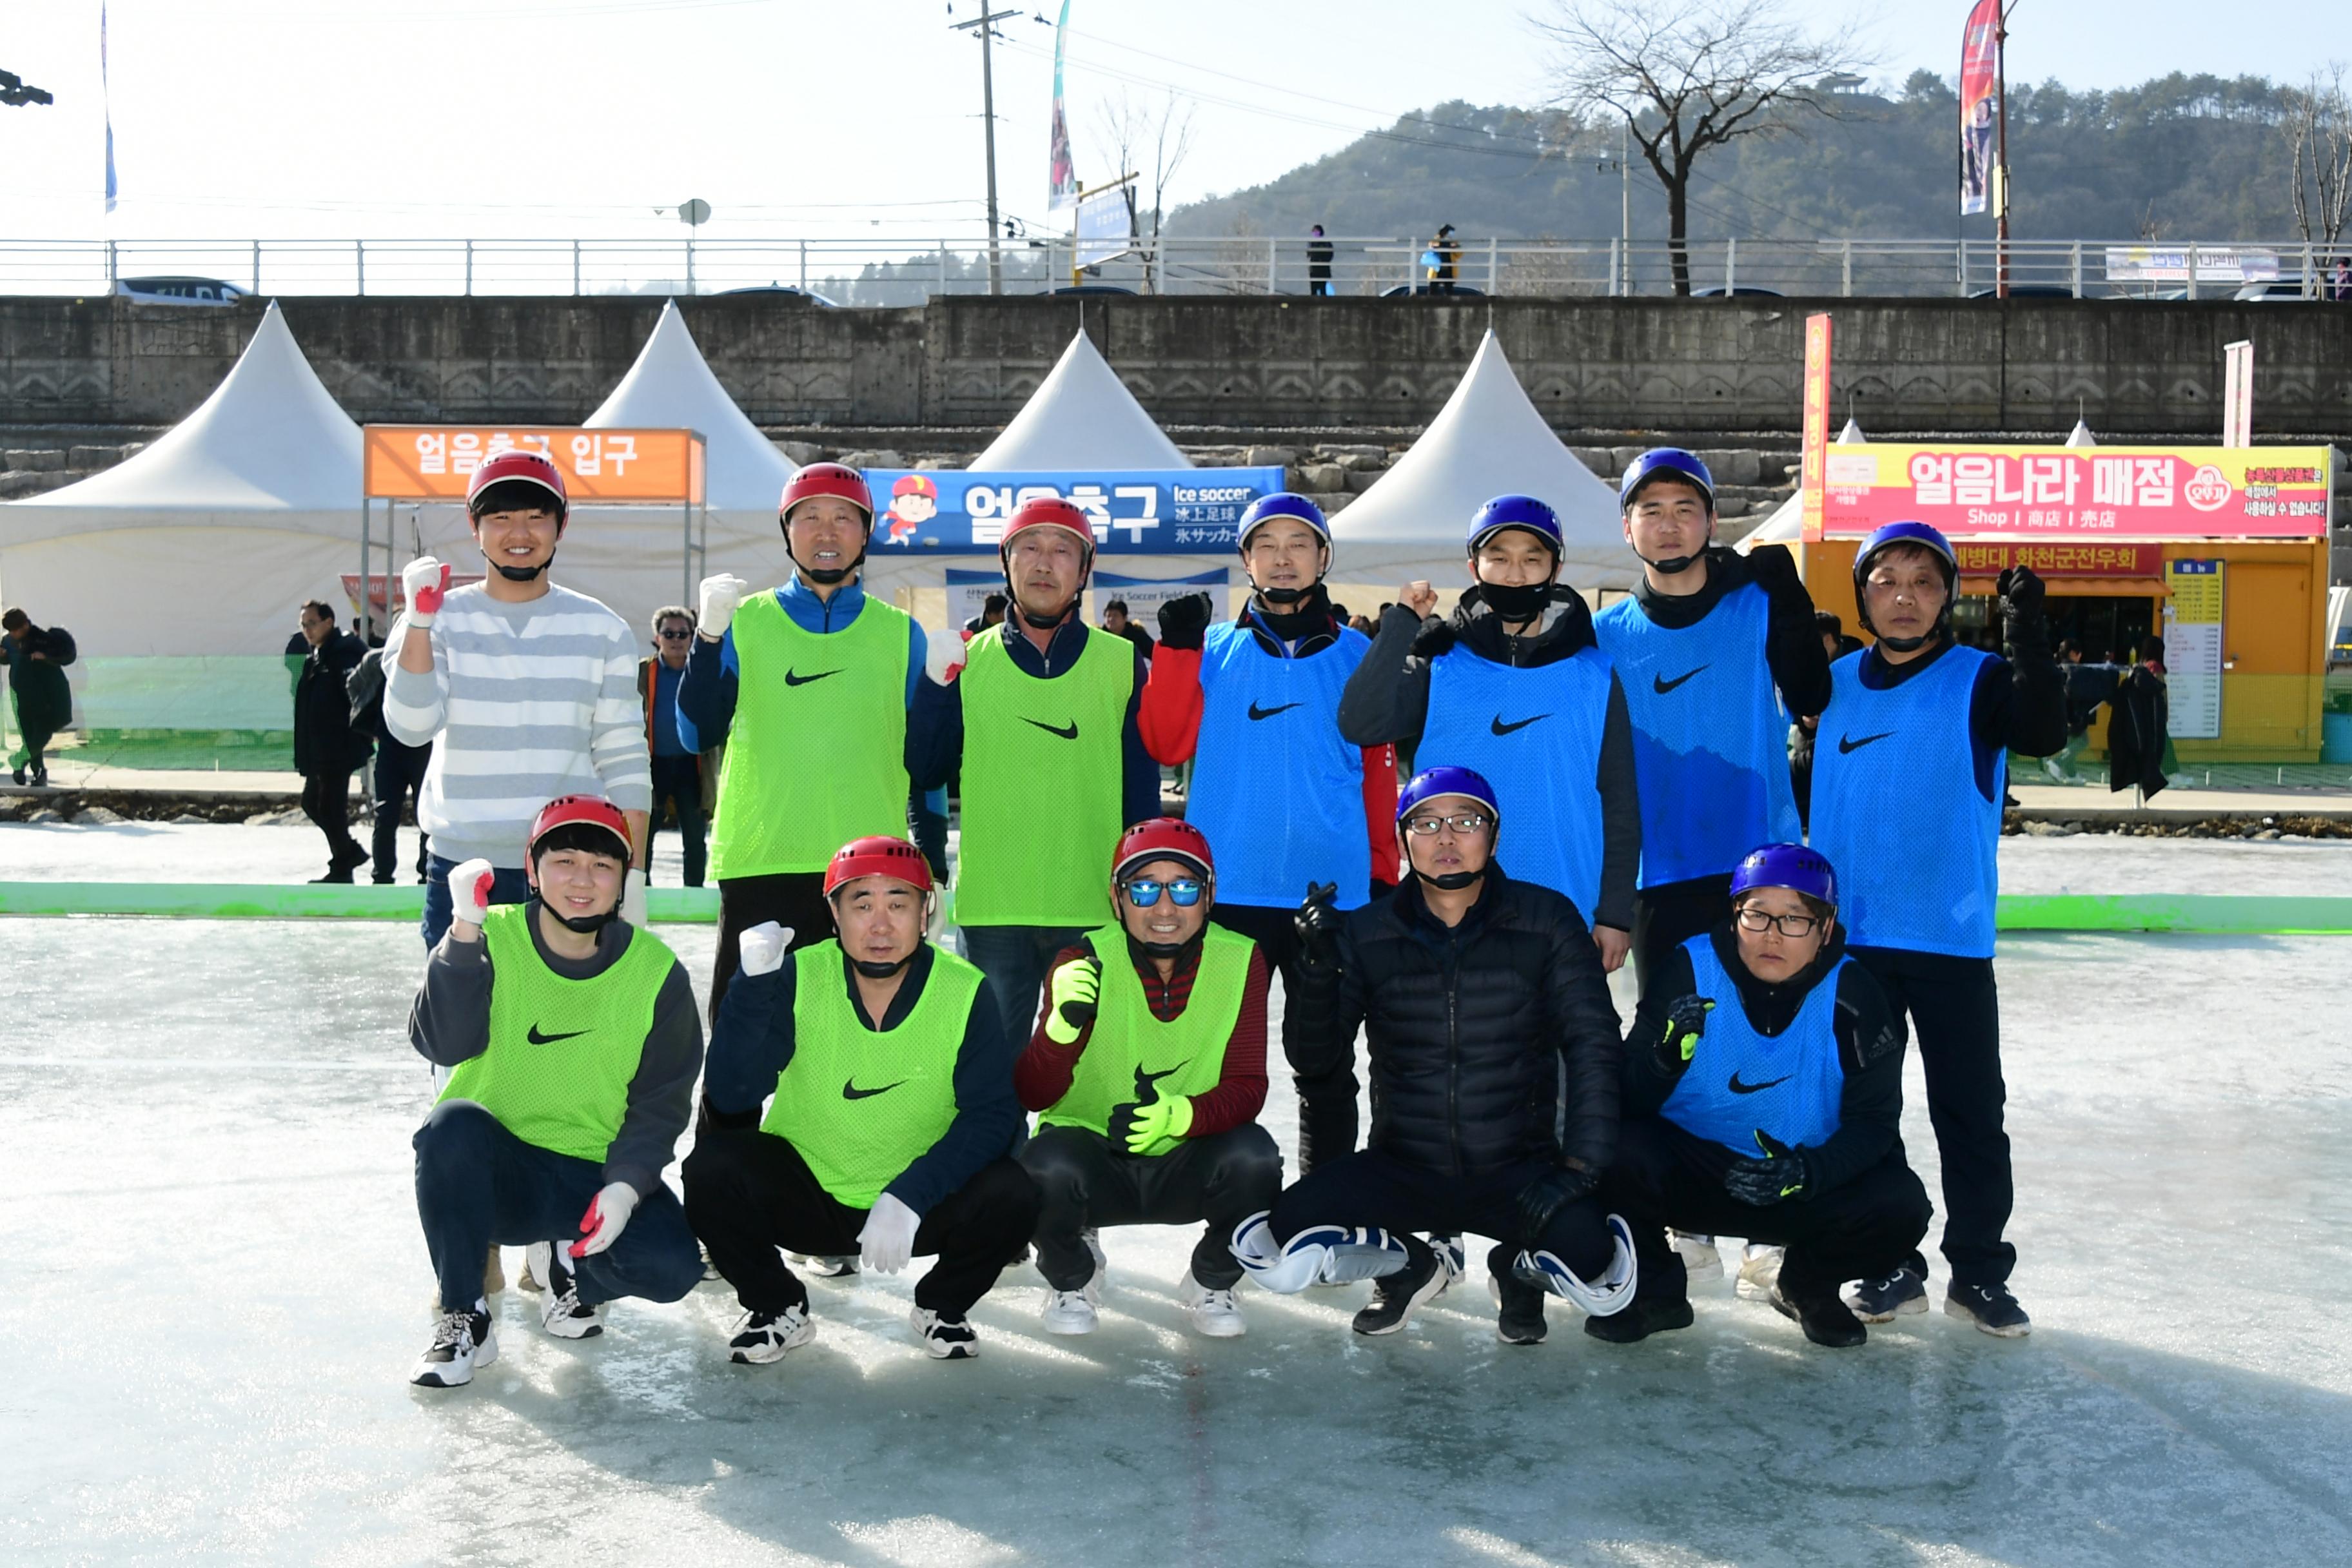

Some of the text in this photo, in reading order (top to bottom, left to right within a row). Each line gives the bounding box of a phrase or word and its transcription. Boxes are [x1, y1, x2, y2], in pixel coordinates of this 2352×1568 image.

[571, 434, 637, 476] 입구
[1912, 455, 2175, 506] 얼음나라 매점
[1173, 485, 1251, 502] Ice soccer
[1968, 508, 2008, 527] Shop
[2244, 501, 2276, 516] 사용하실
[2278, 502, 2286, 516] 수
[2028, 510, 2061, 527] 商店
[2081, 510, 2115, 528] 売店
[2015, 547, 2136, 570] 화천군전우회
[1128, 591, 1157, 600] Soccer
